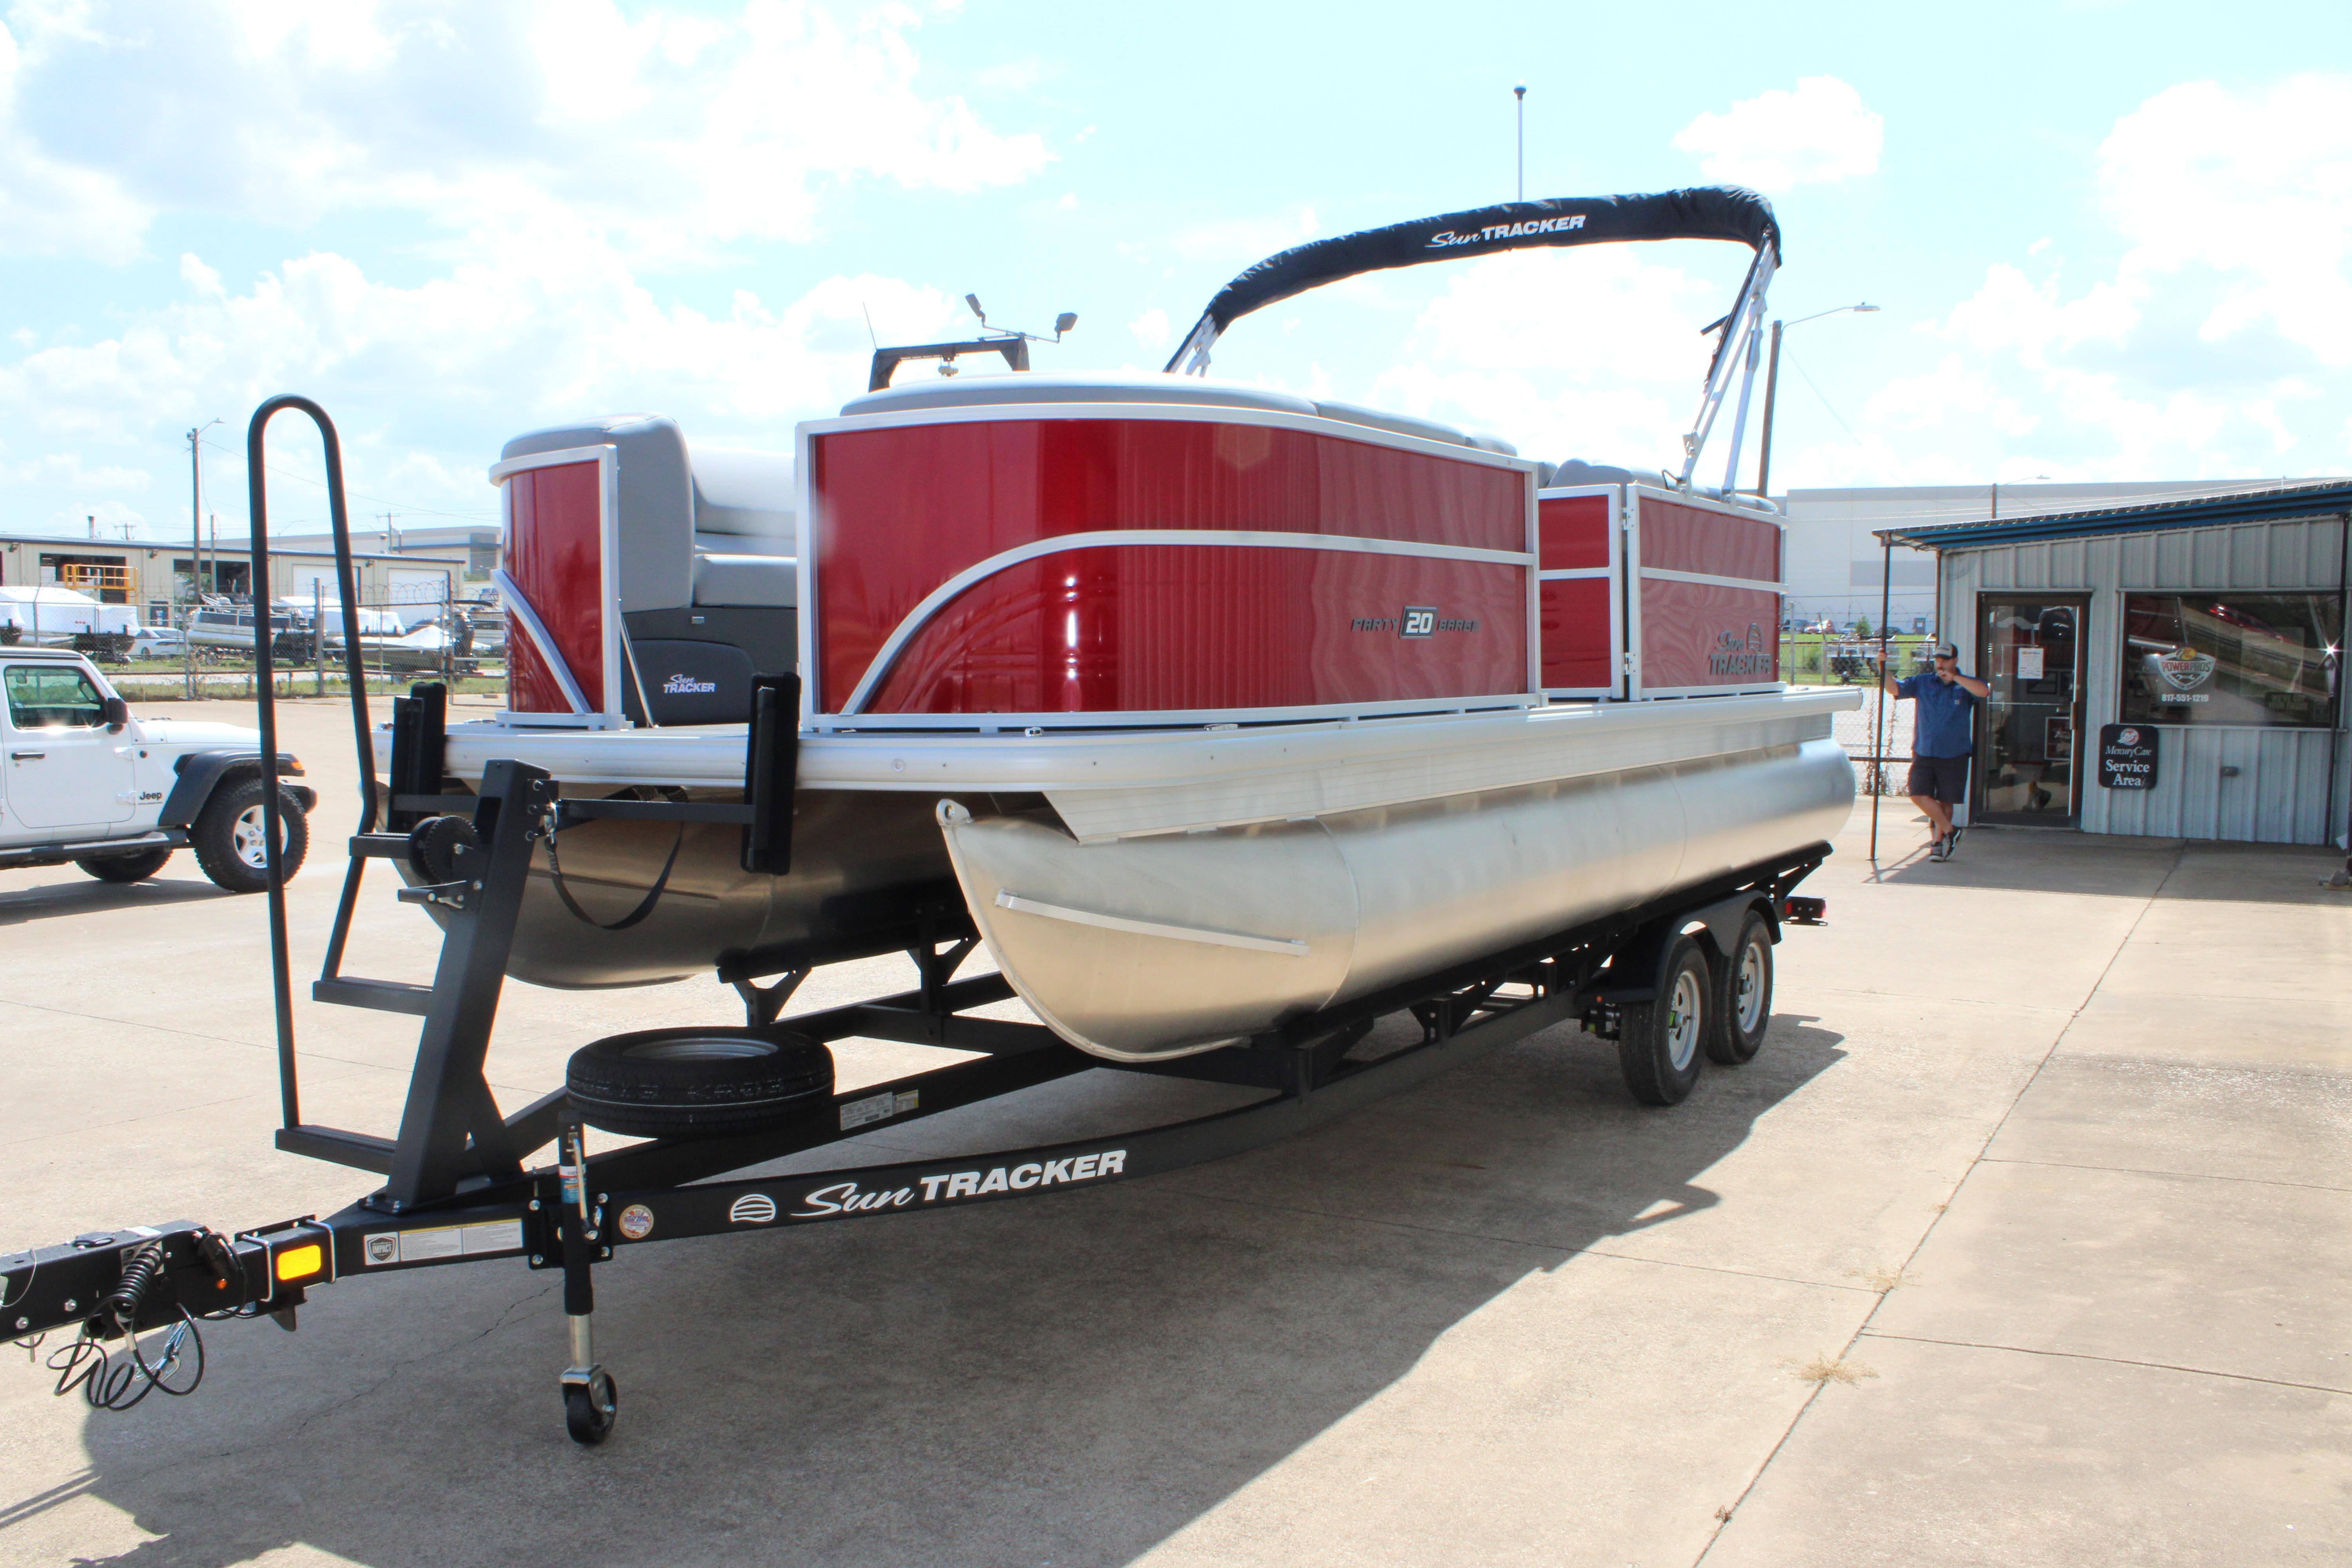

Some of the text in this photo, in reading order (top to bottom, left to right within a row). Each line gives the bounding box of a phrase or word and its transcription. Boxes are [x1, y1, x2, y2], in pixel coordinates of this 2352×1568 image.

[1425, 215, 1586, 248] Sun TRACKER
[1351, 612, 1481, 633] PARTY 20 BARGE
[1714, 630, 1744, 652] Sun
[1708, 654, 1771, 675] TRACKER
[668, 674, 696, 684] Sun
[663, 682, 716, 693] TRACKER
[2106, 759, 2150, 773] Service
[2113, 773, 2141, 786] Area
[140, 791, 162, 800] Jeep
[790, 1149, 1127, 1216] Sun TRACKER
[373, 1243, 392, 1254] IMPACT
